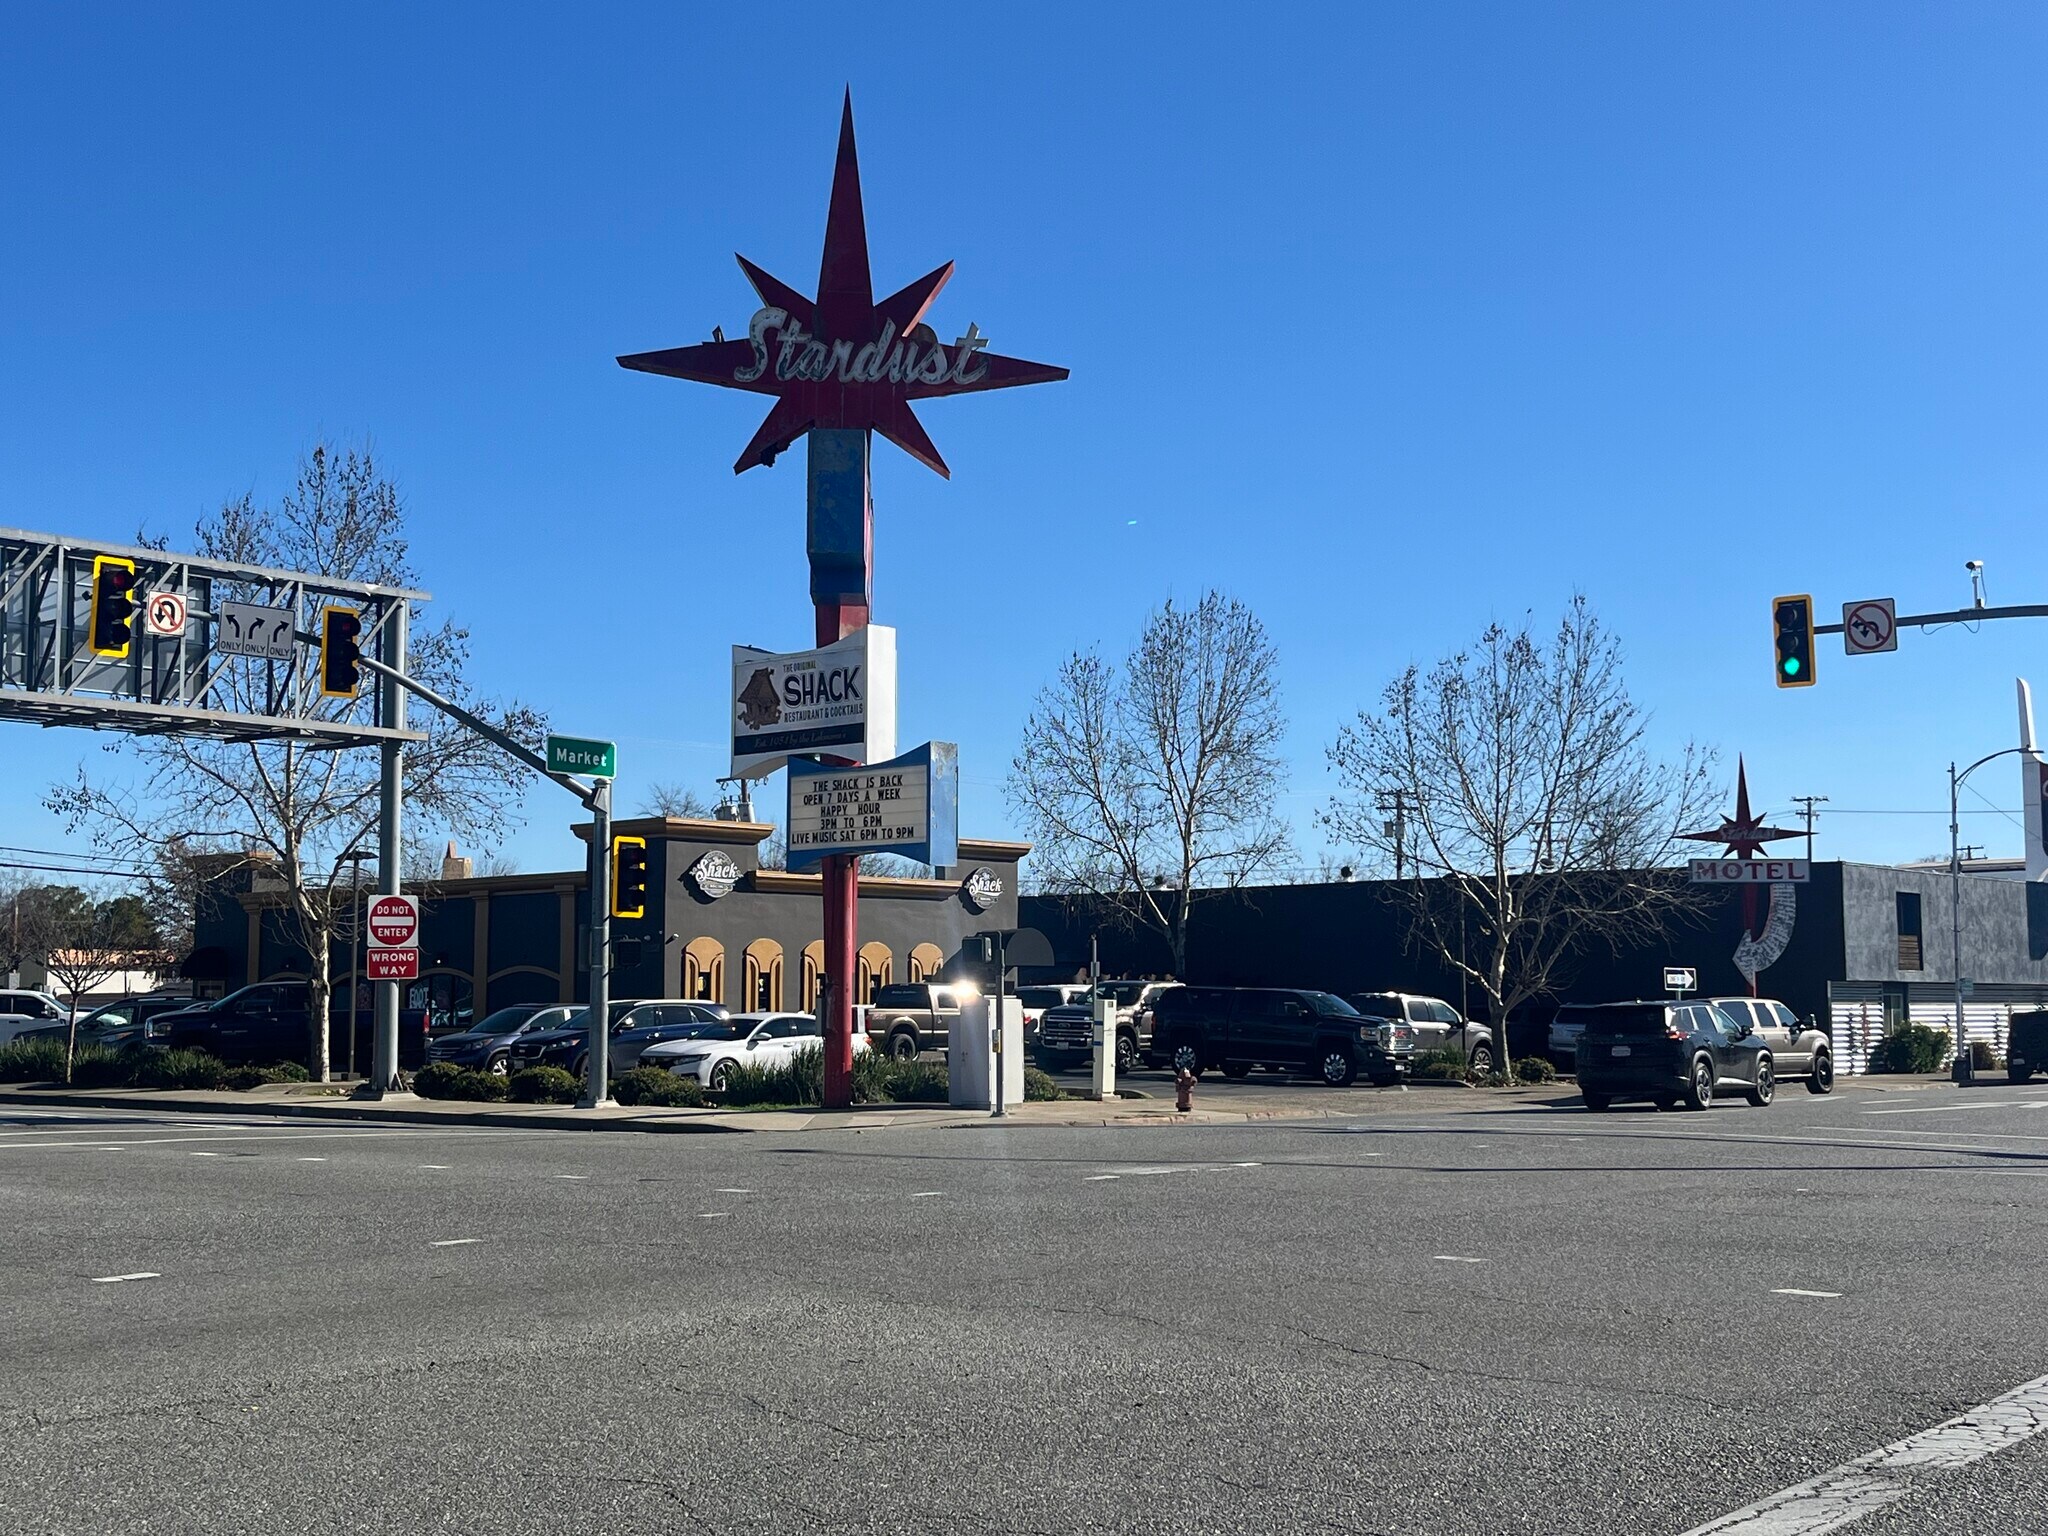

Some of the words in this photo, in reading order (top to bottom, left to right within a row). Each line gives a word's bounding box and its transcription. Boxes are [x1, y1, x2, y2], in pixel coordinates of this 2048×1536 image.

[733, 306, 990, 385] Stardust
[221, 641, 241, 651] ONLY
[245, 644, 266, 654] ONLY
[269, 647, 290, 656] ONLY
[783, 663, 793, 672] THE
[794, 660, 816, 671] ORIGINAL
[783, 665, 863, 709] SHACK
[784, 708, 823, 723] RESTAURANT
[830, 703, 863, 718] COCKTAILS
[556, 747, 607, 767] Market
[813, 781, 828, 792] THE
[833, 778, 859, 791] SHACK
[866, 777, 875, 788] IS
[880, 775, 903, 787] BACK
[803, 793, 823, 805] OPEN
[827, 793, 832, 803] 7
[837, 791, 859, 803] DAYS
[865, 790, 870, 801] A
[878, 788, 901, 800] WEEK
[820, 804, 848, 817] HAPPY
[858, 803, 880, 815] HOUR
[820, 818, 837, 830] 3PM
[844, 817, 854, 828] TO
[863, 815, 882, 827] 6PM
[792, 832, 809, 844] LIVE
[812, 831, 837, 843] MUSIC
[840, 830, 856, 841] SAT
[860, 829, 877, 840] 6PM
[881, 828, 893, 839] TO
[896, 827, 914, 838] 9PM
[695, 859, 738, 882] Shack
[1696, 862, 1805, 880] MOTEL
[969, 874, 1003, 895] Shack
[377, 906, 389, 915] DO
[392, 906, 409, 915] NOT
[378, 928, 408, 937] ENTER
[371, 953, 415, 962] WRONG
[379, 966, 407, 975] WAY
